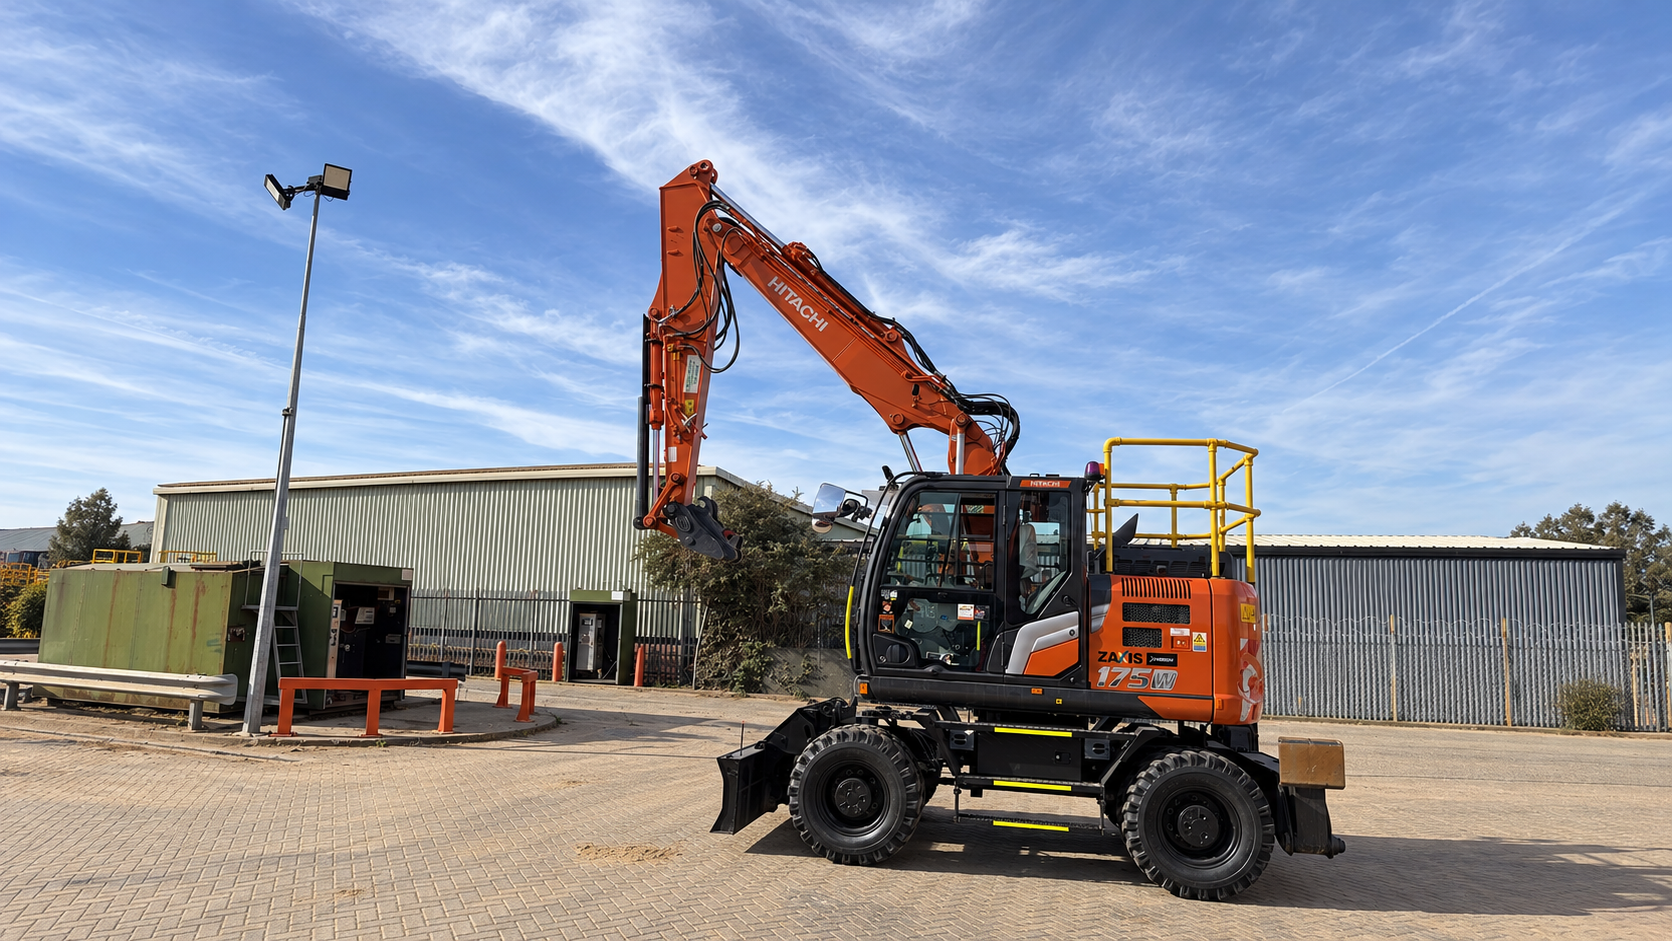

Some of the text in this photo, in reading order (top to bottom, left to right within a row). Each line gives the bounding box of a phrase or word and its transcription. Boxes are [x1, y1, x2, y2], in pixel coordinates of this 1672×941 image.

[767, 276, 829, 332] HITACHI
[1097, 651, 1143, 664] ZAXIS
[1096, 666, 1179, 691] 175W
